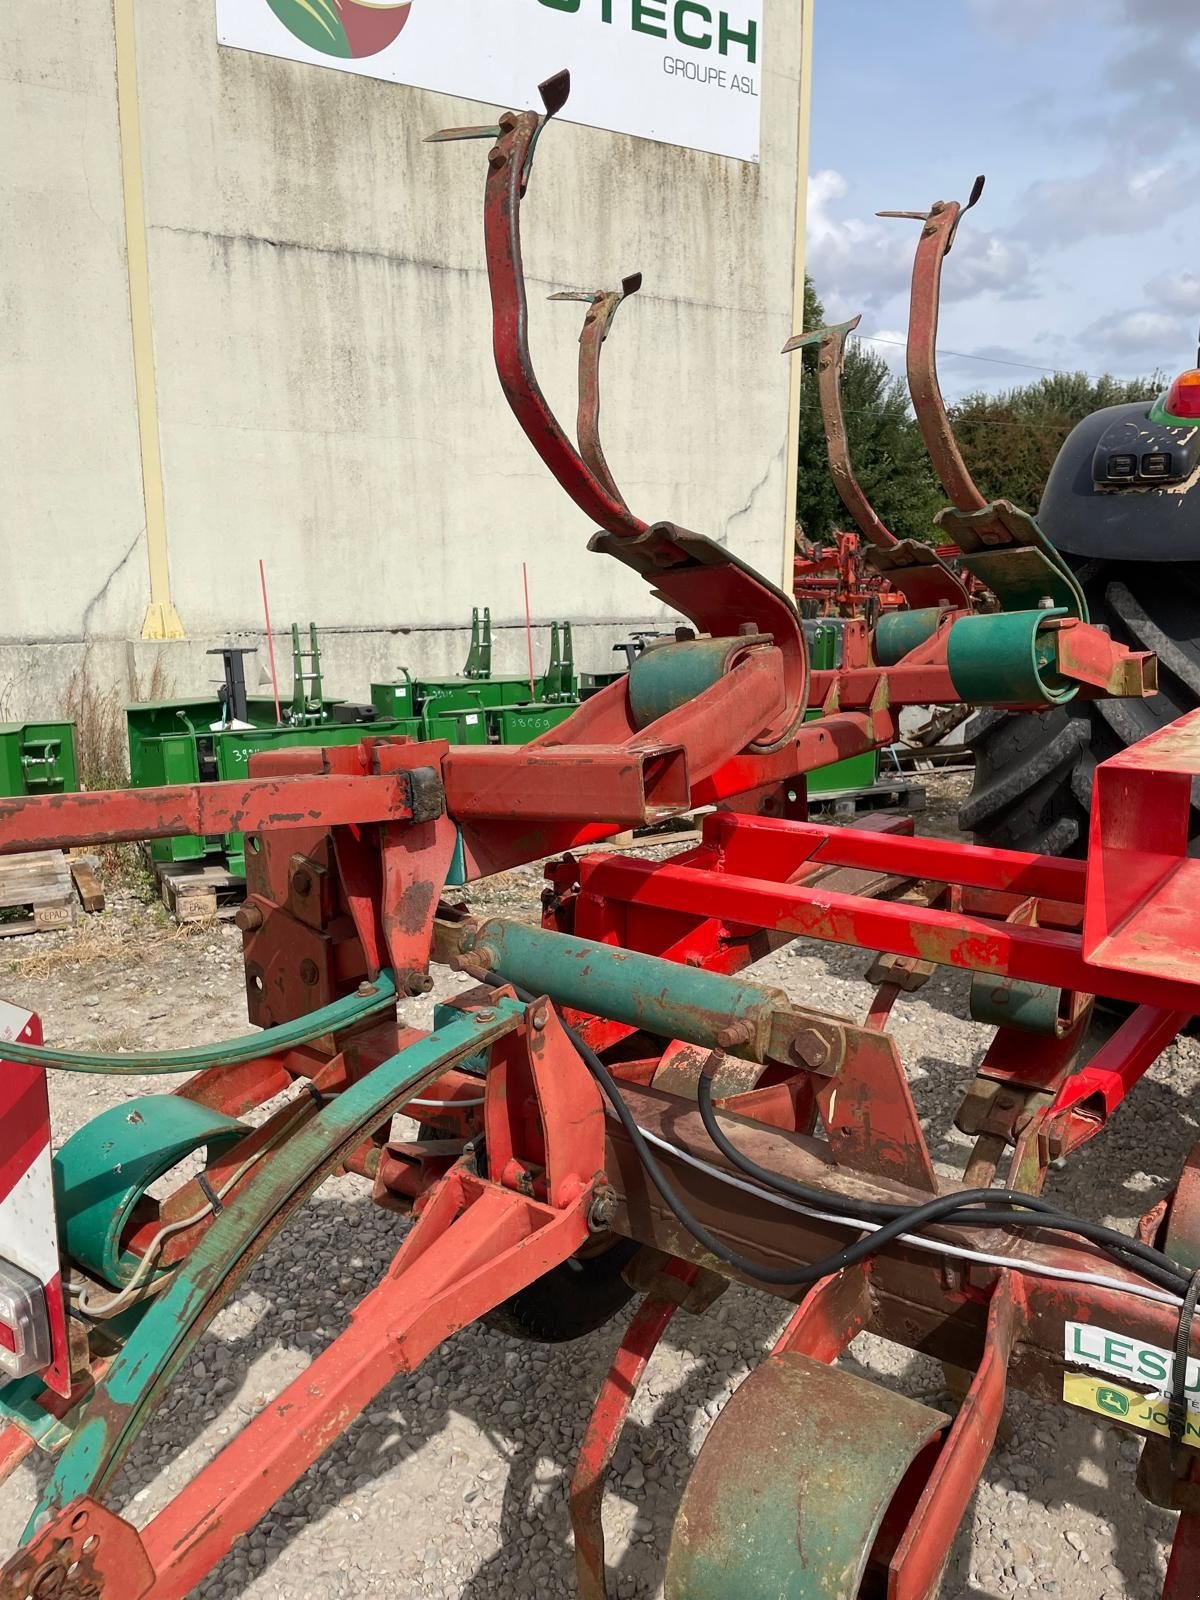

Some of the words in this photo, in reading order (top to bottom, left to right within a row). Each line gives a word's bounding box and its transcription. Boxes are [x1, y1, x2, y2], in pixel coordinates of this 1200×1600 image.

[537, 0, 757, 64] ECH
[663, 56, 727, 89] GROUPE
[729, 74, 759, 96] ASL
[1138, 1406, 1200, 1438] JON
